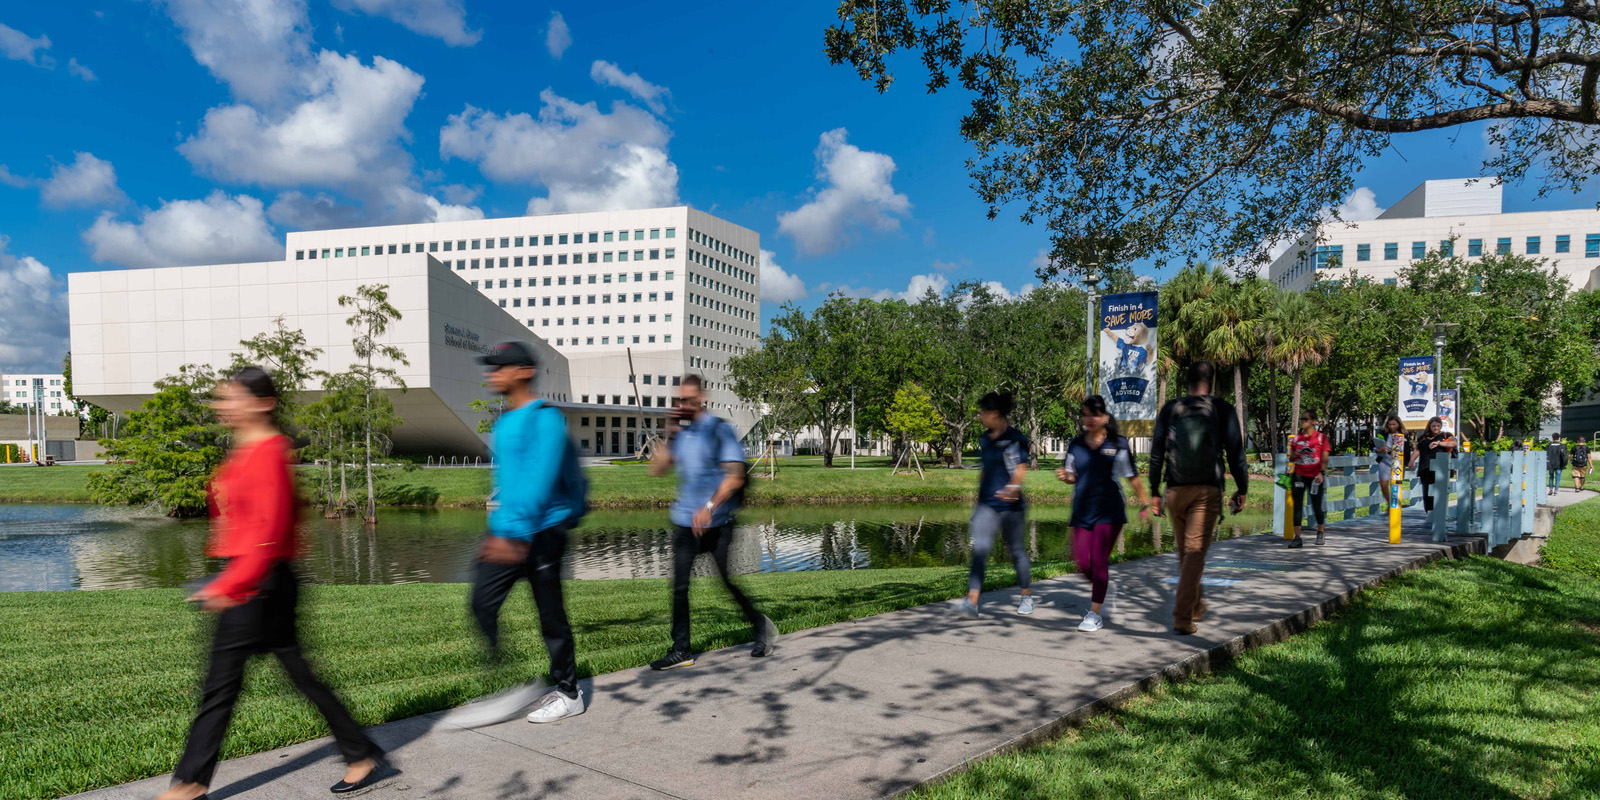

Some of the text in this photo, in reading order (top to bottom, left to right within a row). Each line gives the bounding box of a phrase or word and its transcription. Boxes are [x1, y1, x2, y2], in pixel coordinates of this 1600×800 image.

[1108, 304, 1128, 312] Finish
[1104, 308, 1153, 328] SAVE MORE
[1115, 389, 1141, 397] ADVISED
